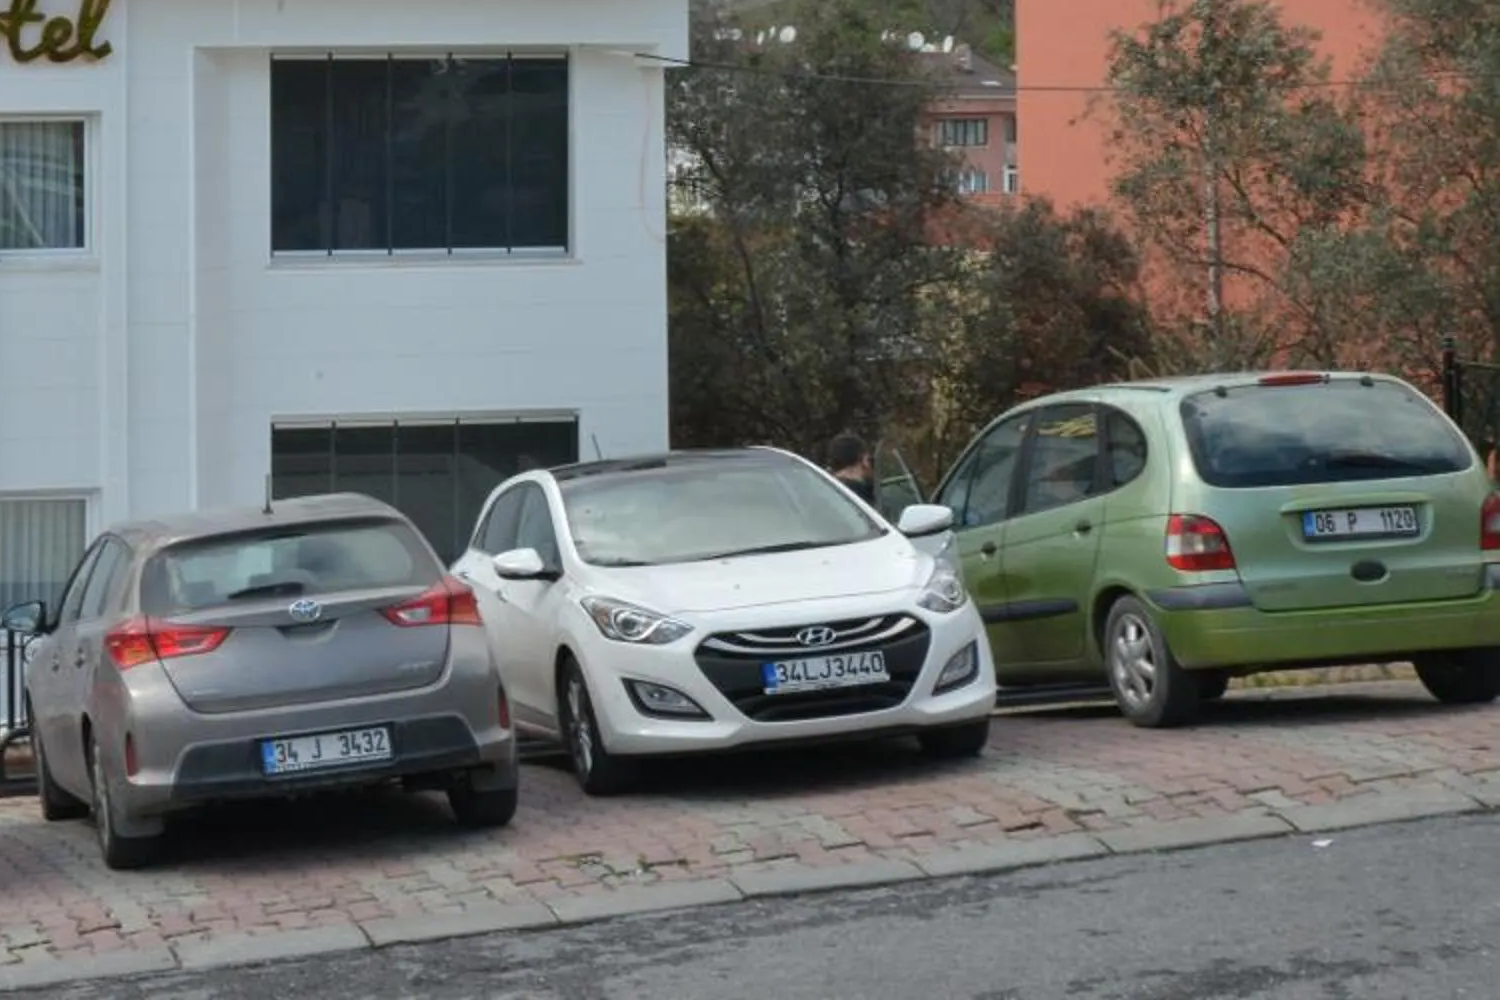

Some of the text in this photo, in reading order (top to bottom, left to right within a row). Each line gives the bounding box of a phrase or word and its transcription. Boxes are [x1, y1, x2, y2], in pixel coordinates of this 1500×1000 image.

[1347, 511, 1357, 532] P
[276, 729, 386, 764] 34 J 3432
